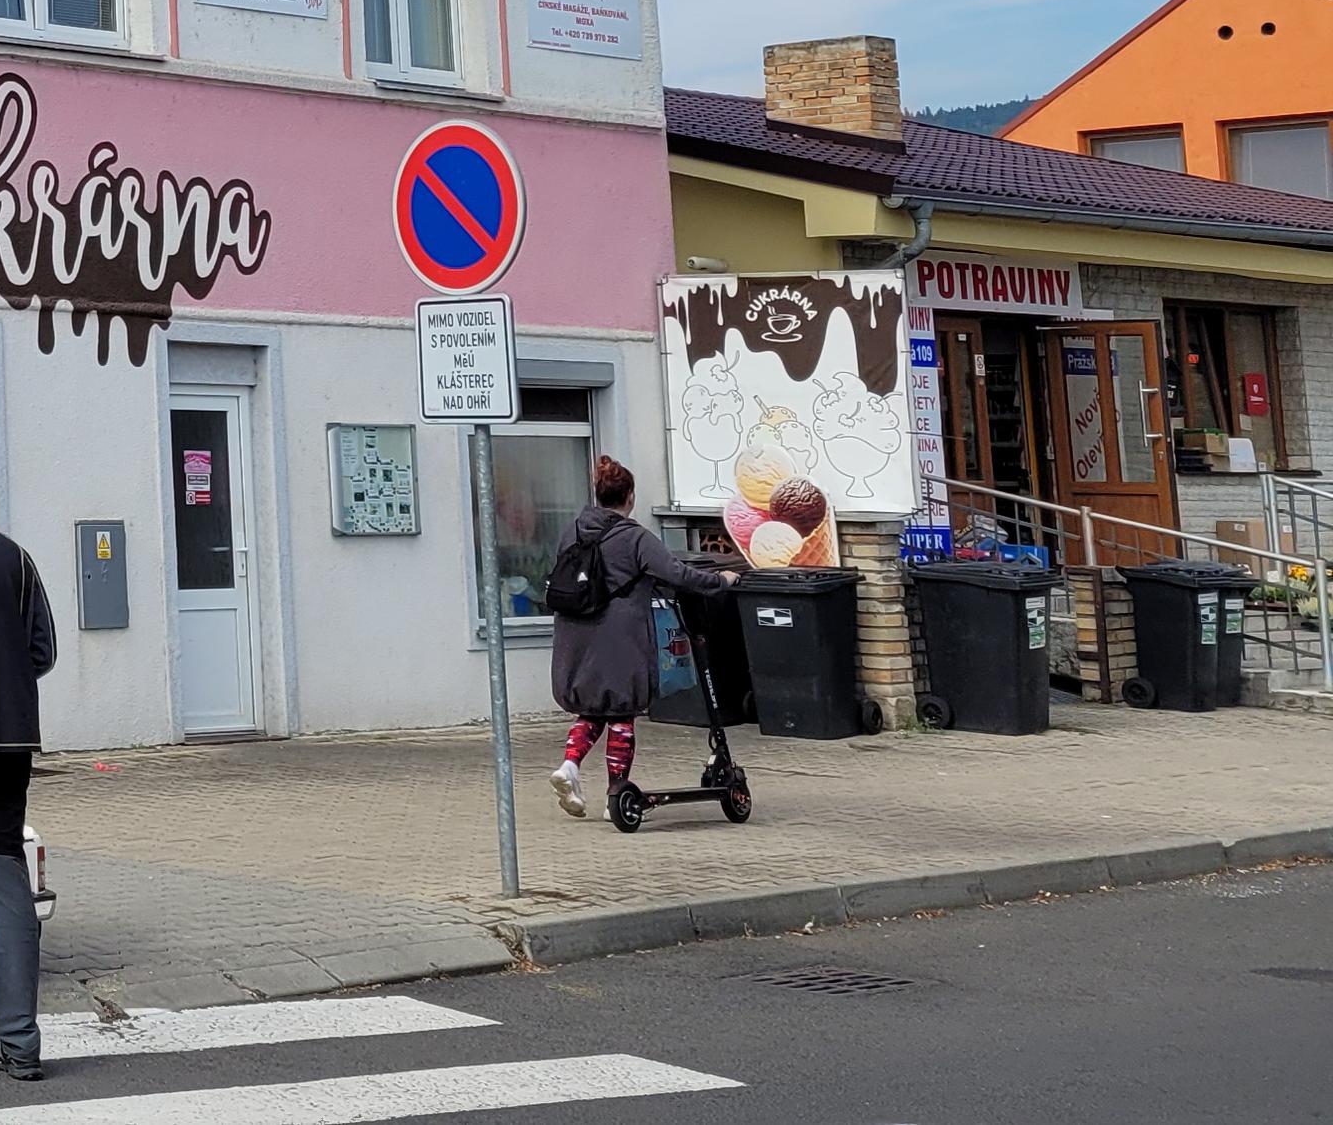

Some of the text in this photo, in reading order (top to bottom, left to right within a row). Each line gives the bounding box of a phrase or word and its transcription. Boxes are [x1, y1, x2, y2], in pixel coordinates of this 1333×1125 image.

[917, 259, 1071, 307] POTRAVINY
[745, 285, 818, 321] CUKRÁRNA
[428, 311, 496, 328] MIMO VOZIDEL
[431, 329, 496, 348] S POVOLENÍM
[453, 350, 475, 368] MěÚ
[917, 345, 933, 362] 109
[1068, 354, 1115, 371] Pražsk
[437, 370, 494, 389] KLÁŠTEREC
[443, 391, 491, 410] NAD OHŘÍ
